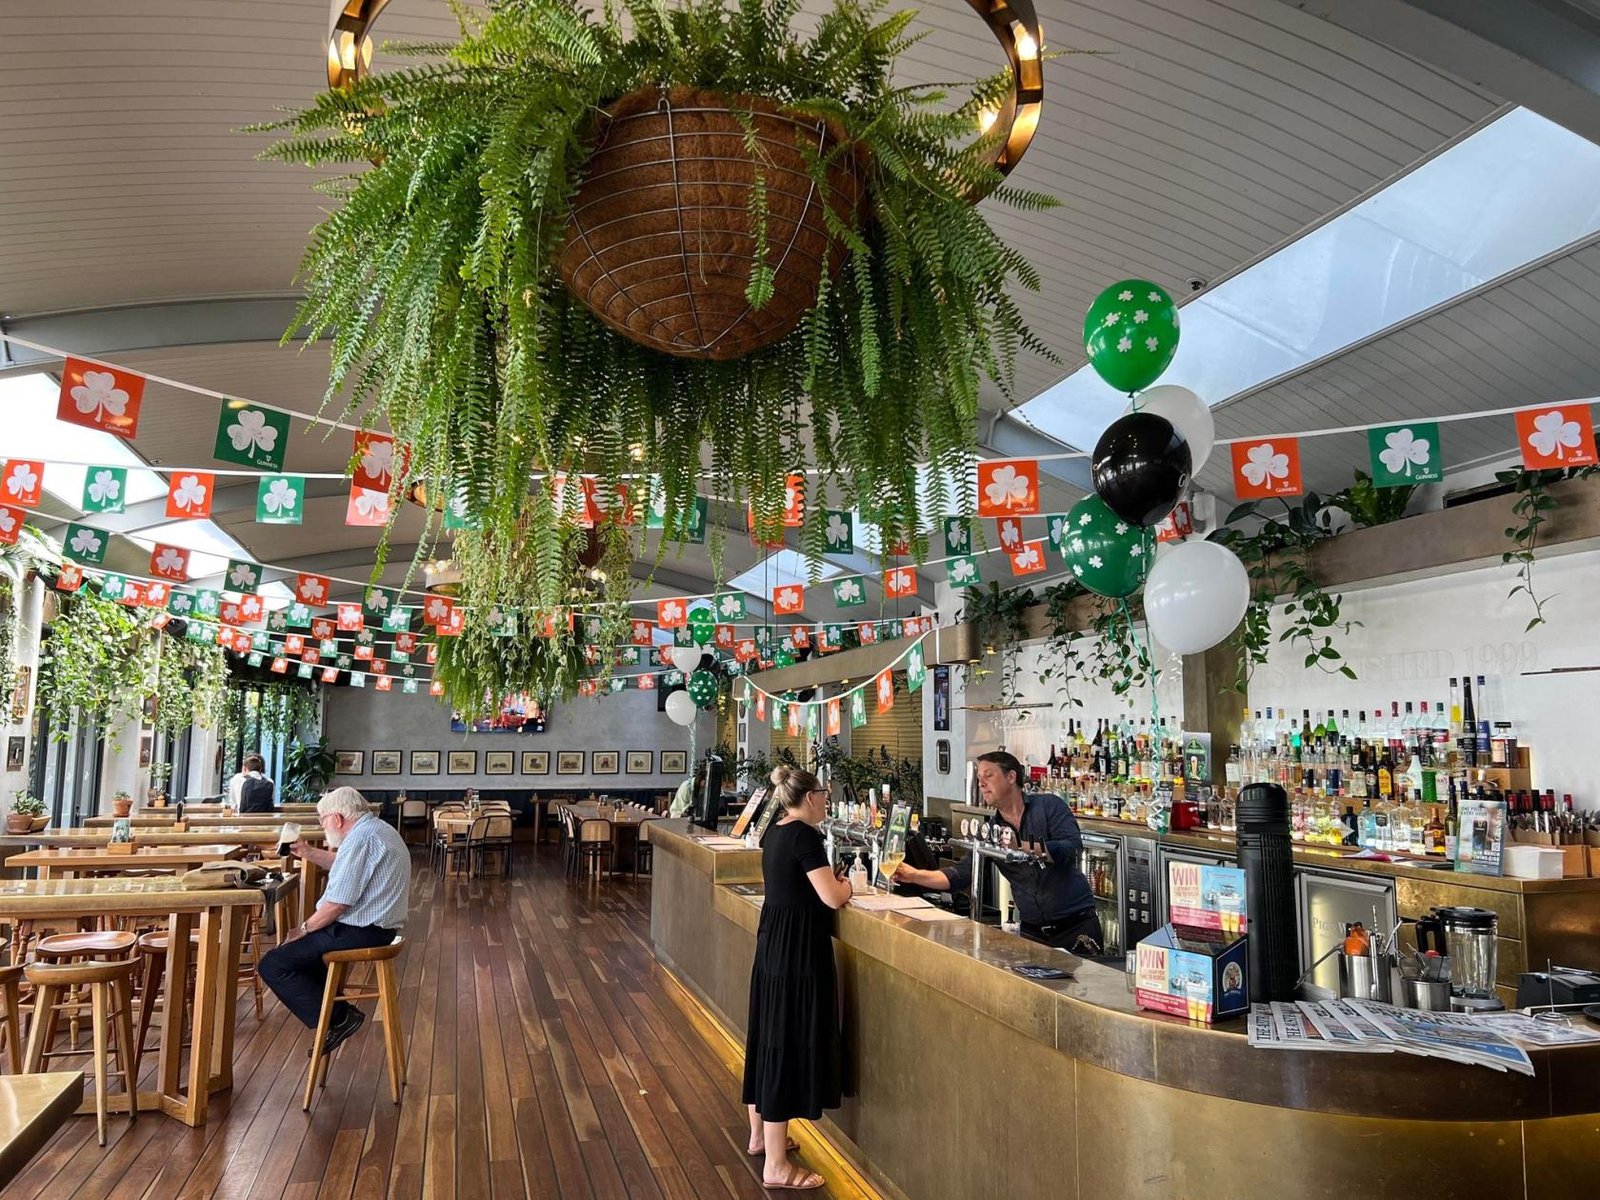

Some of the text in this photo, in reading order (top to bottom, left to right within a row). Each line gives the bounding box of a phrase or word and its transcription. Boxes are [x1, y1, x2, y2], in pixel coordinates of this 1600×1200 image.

[256, 459, 278, 470] GUINNESS
[1172, 868, 1198, 886] WIN
[1139, 949, 1164, 969] WIN
